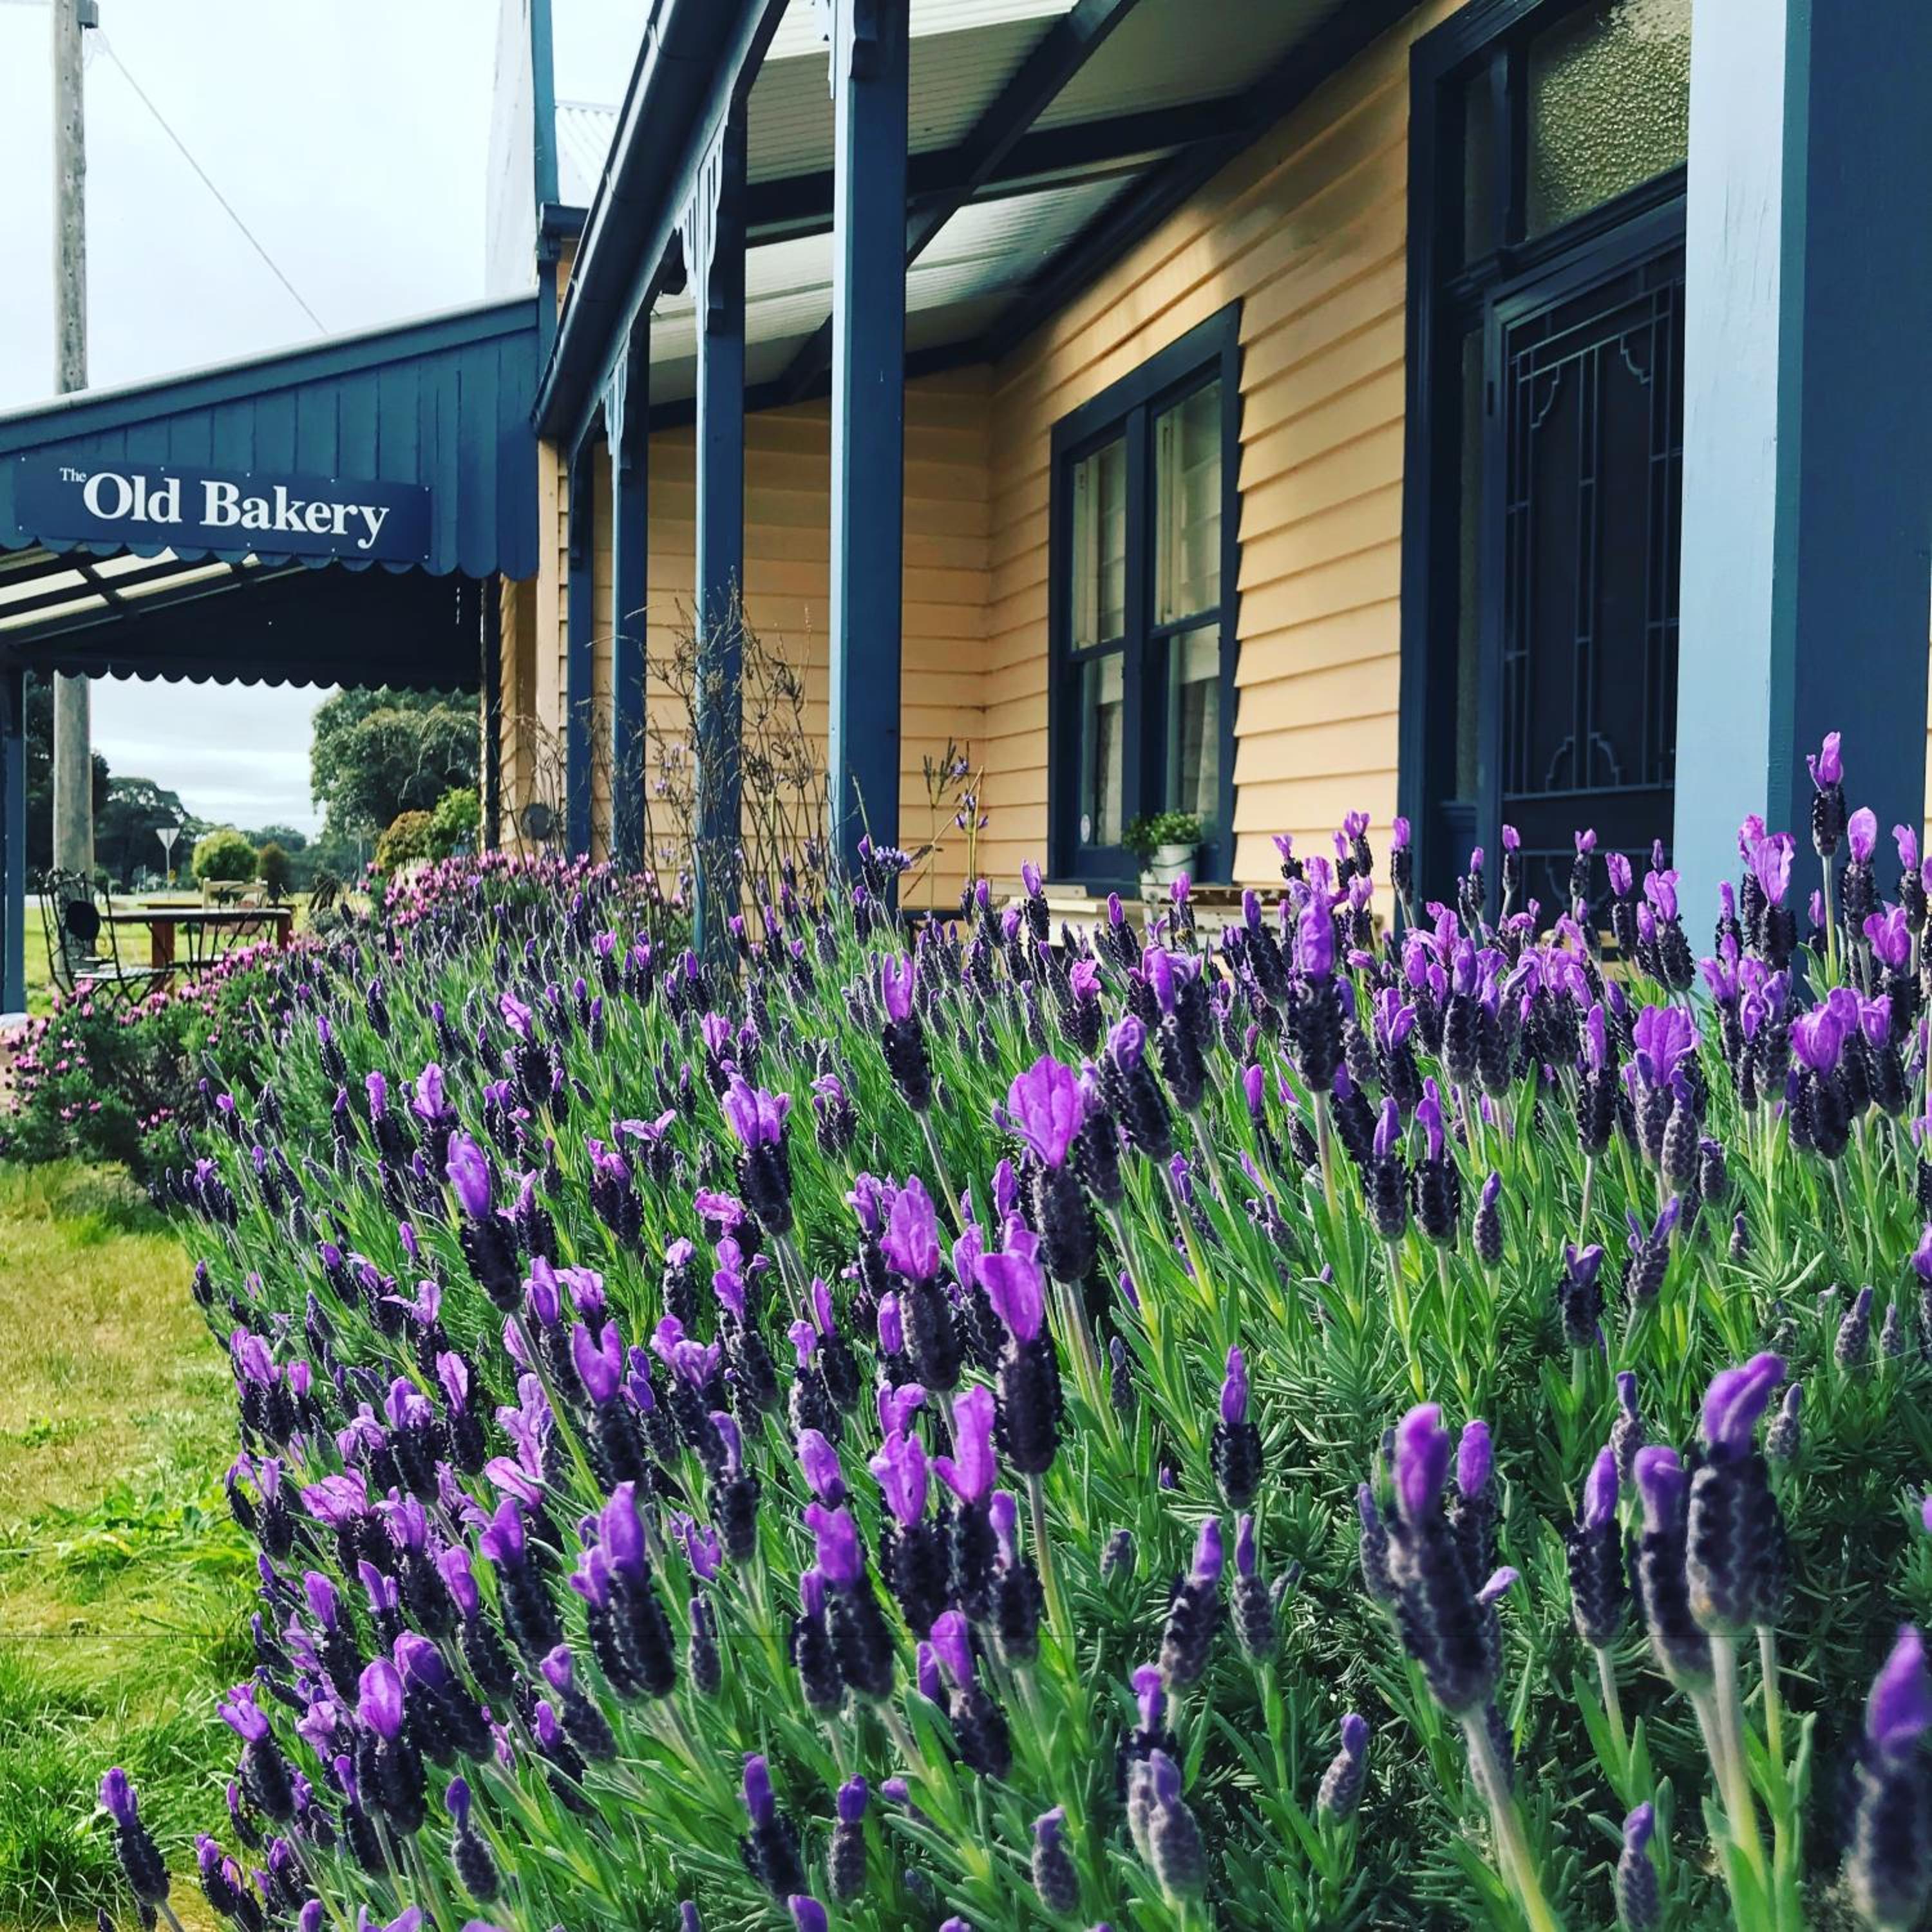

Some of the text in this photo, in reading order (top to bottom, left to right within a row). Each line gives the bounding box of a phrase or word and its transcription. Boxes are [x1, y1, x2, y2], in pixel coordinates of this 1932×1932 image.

[59, 467, 390, 549] The Old Bakery
